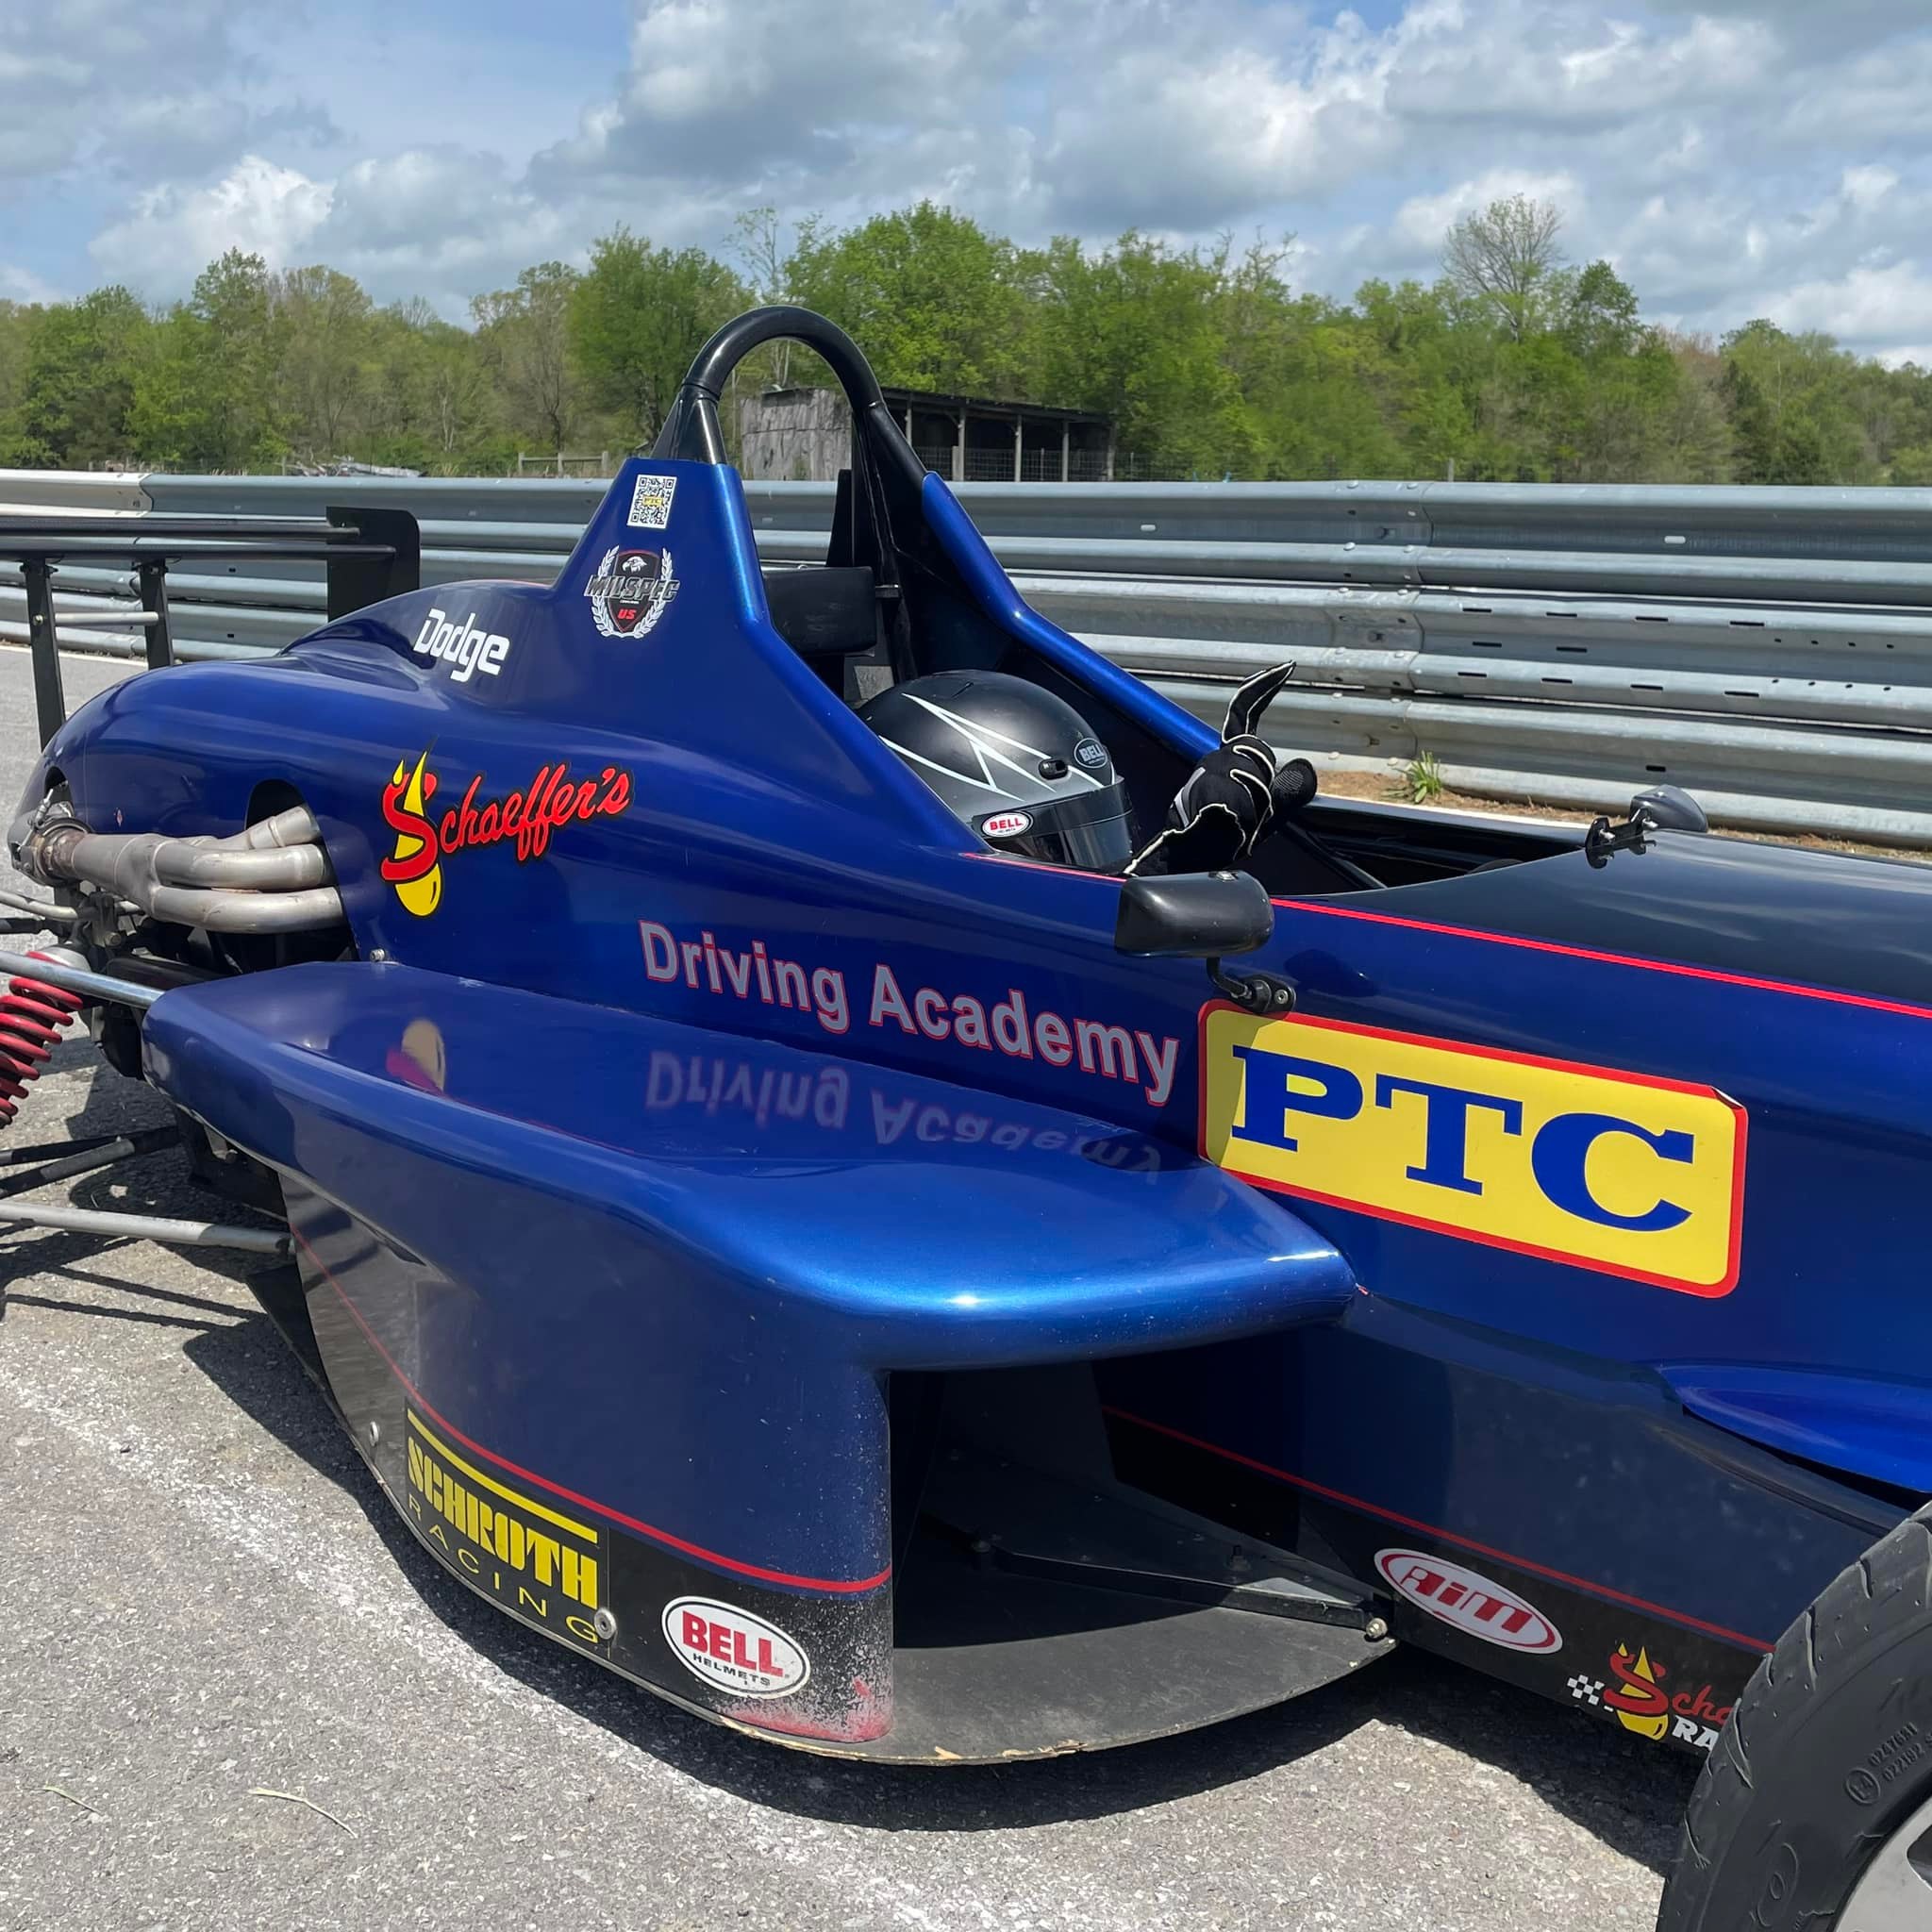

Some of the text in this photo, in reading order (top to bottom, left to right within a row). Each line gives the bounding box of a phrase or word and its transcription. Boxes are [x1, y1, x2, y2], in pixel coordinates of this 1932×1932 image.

[583, 574, 681, 603] MILSPEC
[617, 608, 637, 621] US
[413, 608, 510, 683] Dodge
[1078, 743, 1105, 762] BELL
[380, 762, 630, 882] Schaeffer's
[990, 817, 1024, 831] BELL
[638, 918, 1181, 1108] Driving Academy
[1231, 1043, 1695, 1233] PTC
[408, 1436, 598, 1610] SCHROTH
[408, 1492, 599, 1644] RACING
[682, 1609, 784, 1677] BELL
[691, 1652, 771, 1687] HELMETS
